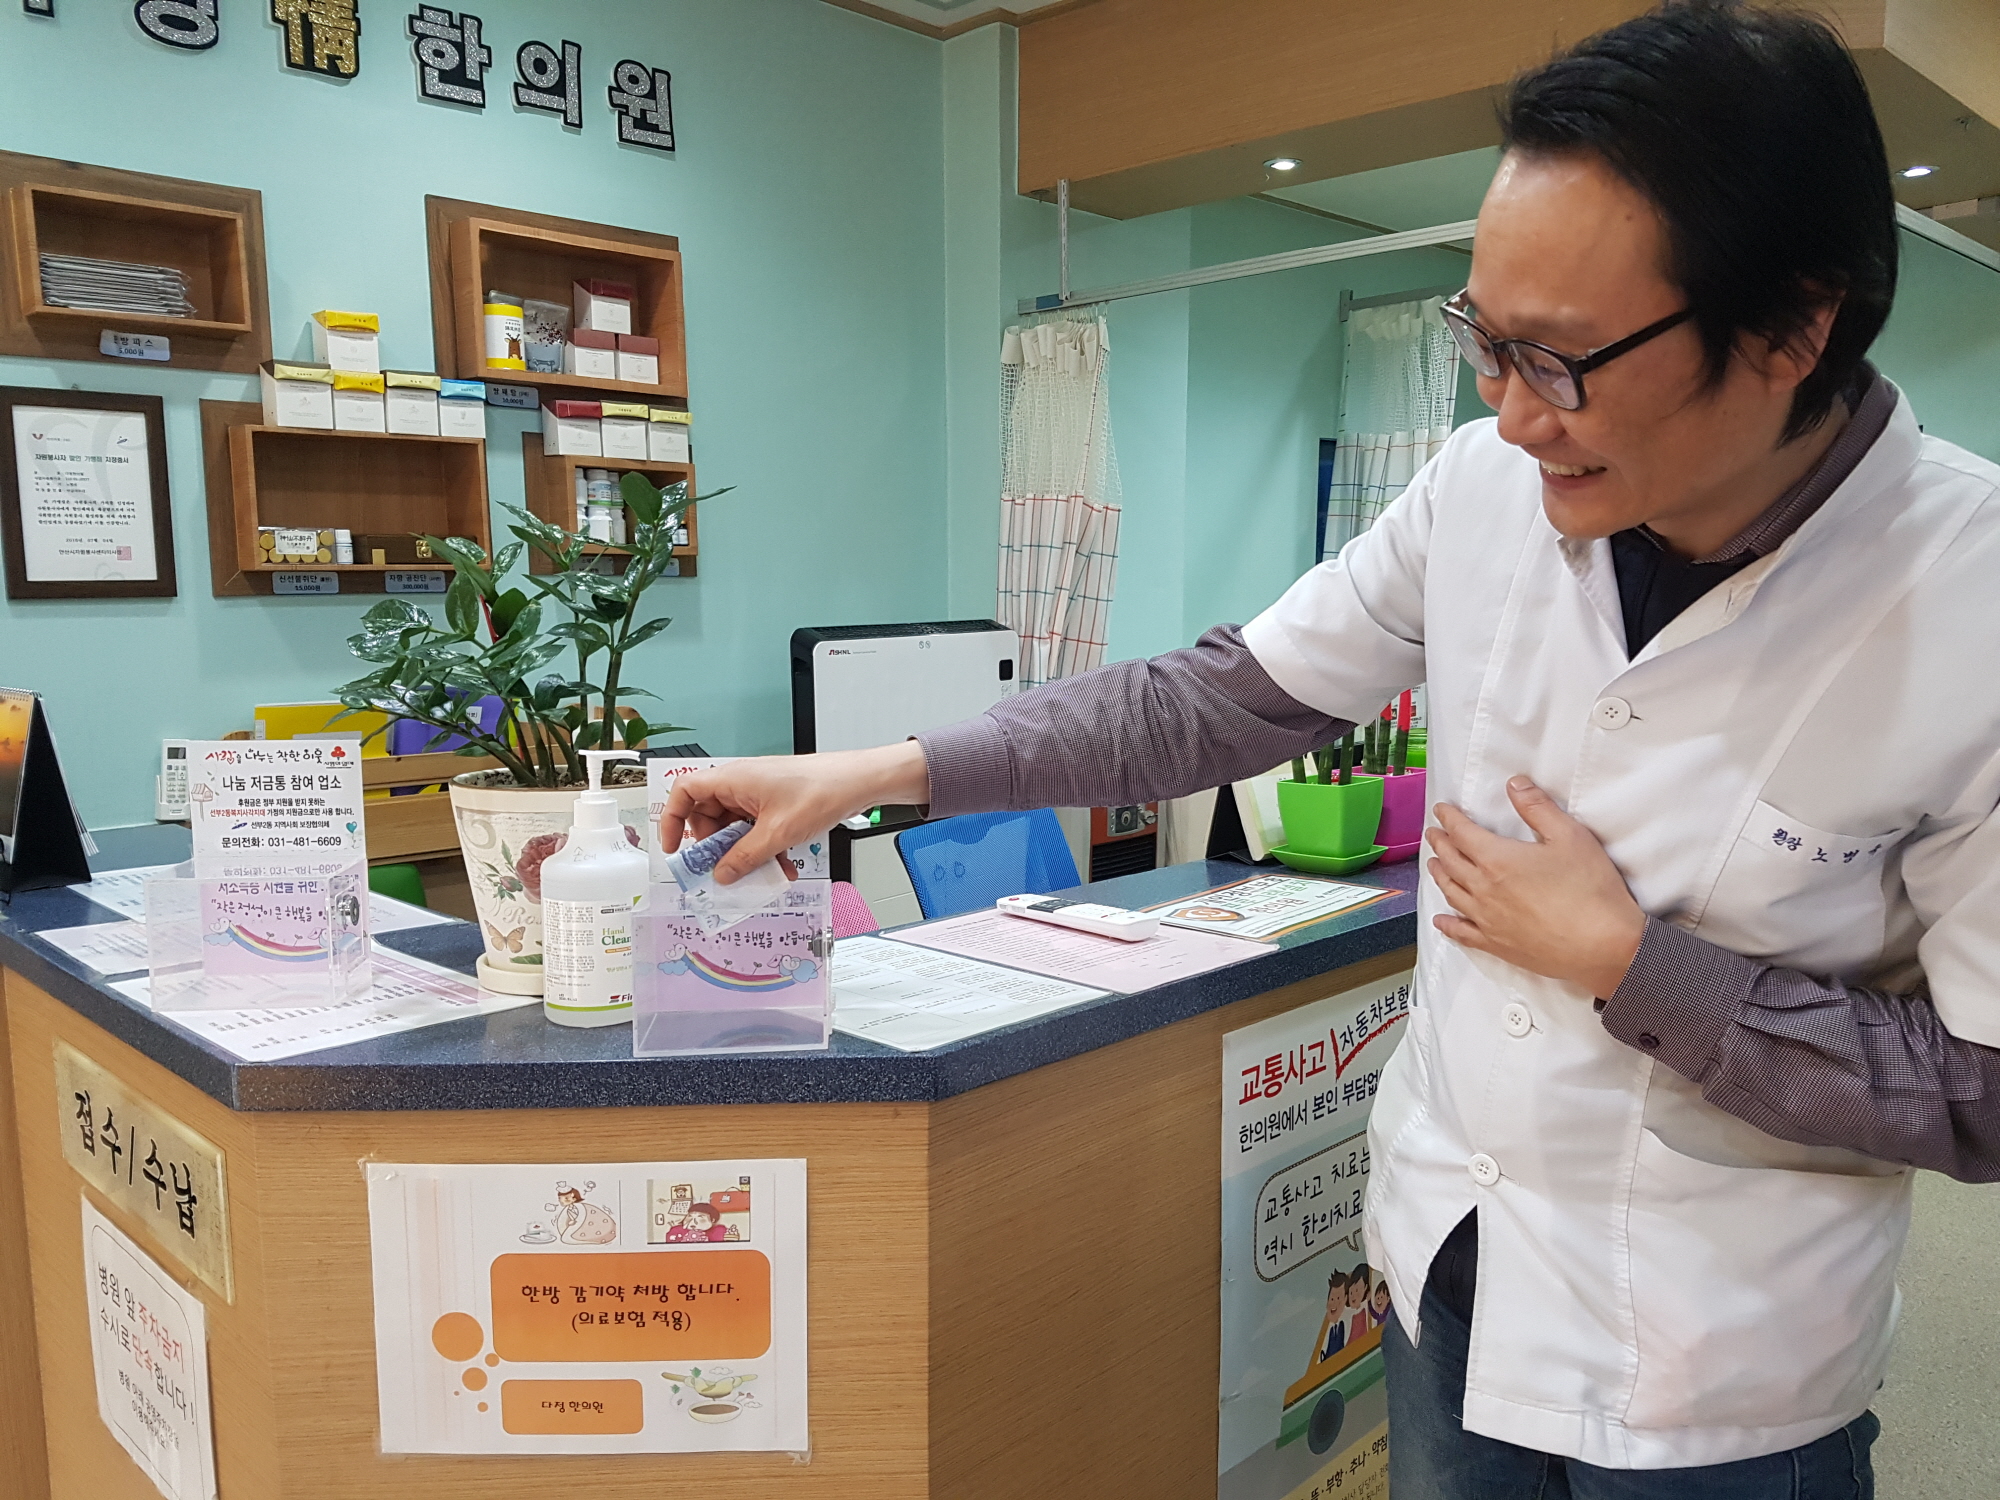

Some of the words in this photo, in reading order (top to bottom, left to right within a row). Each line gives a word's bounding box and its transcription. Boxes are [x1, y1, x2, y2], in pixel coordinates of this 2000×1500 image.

[408, 4, 676, 152] 한의원
[276, 749, 300, 763] 착한
[303, 748, 323, 765] 이웃
[223, 775, 246, 791] 나눔
[250, 775, 286, 791] 저금통
[291, 775, 314, 791] 참여
[318, 774, 342, 790] 업소
[238, 798, 261, 807] 후원금은
[262, 798, 275, 807] 정부
[276, 798, 293, 807] 지원을
[295, 798, 307, 806] 받지
[308, 798, 325, 807] 못하는
[267, 809, 284, 817] 가정의
[286, 808, 320, 817] 지원금으로만
[322, 808, 333, 816] 사용
[251, 821, 272, 829] 선부2동
[221, 836, 265, 848] 문의전화:
[268, 836, 342, 848] 031-481-6609
[1772, 828, 1802, 851] 원장
[602, 926, 625, 936] Hand
[744, 931, 774, 949] 행복을
[1238, 1040, 1327, 1106] 교통사고
[1238, 1099, 1308, 1153] 한의원에서
[1312, 1086, 1338, 1120] 본인
[1264, 1175, 1324, 1223] 교통사고
[1264, 1232, 1293, 1266] 역시
[520, 1283, 561, 1304] 한방
[568, 1283, 626, 1304] 감기약
[632, 1283, 671, 1303] 처방
[676, 1281, 741, 1303] 합니다.
[98, 1261, 121, 1308] 병원
[124, 1287, 136, 1323] 앞
[138, 1301, 185, 1375] 주차금지
[100, 1306, 131, 1353] 수시로
[570, 1309, 646, 1334] (의료보험
[651, 1309, 692, 1333] 적용)
[540, 1399, 566, 1414] 다정
[567, 1398, 605, 1415] 한의원
